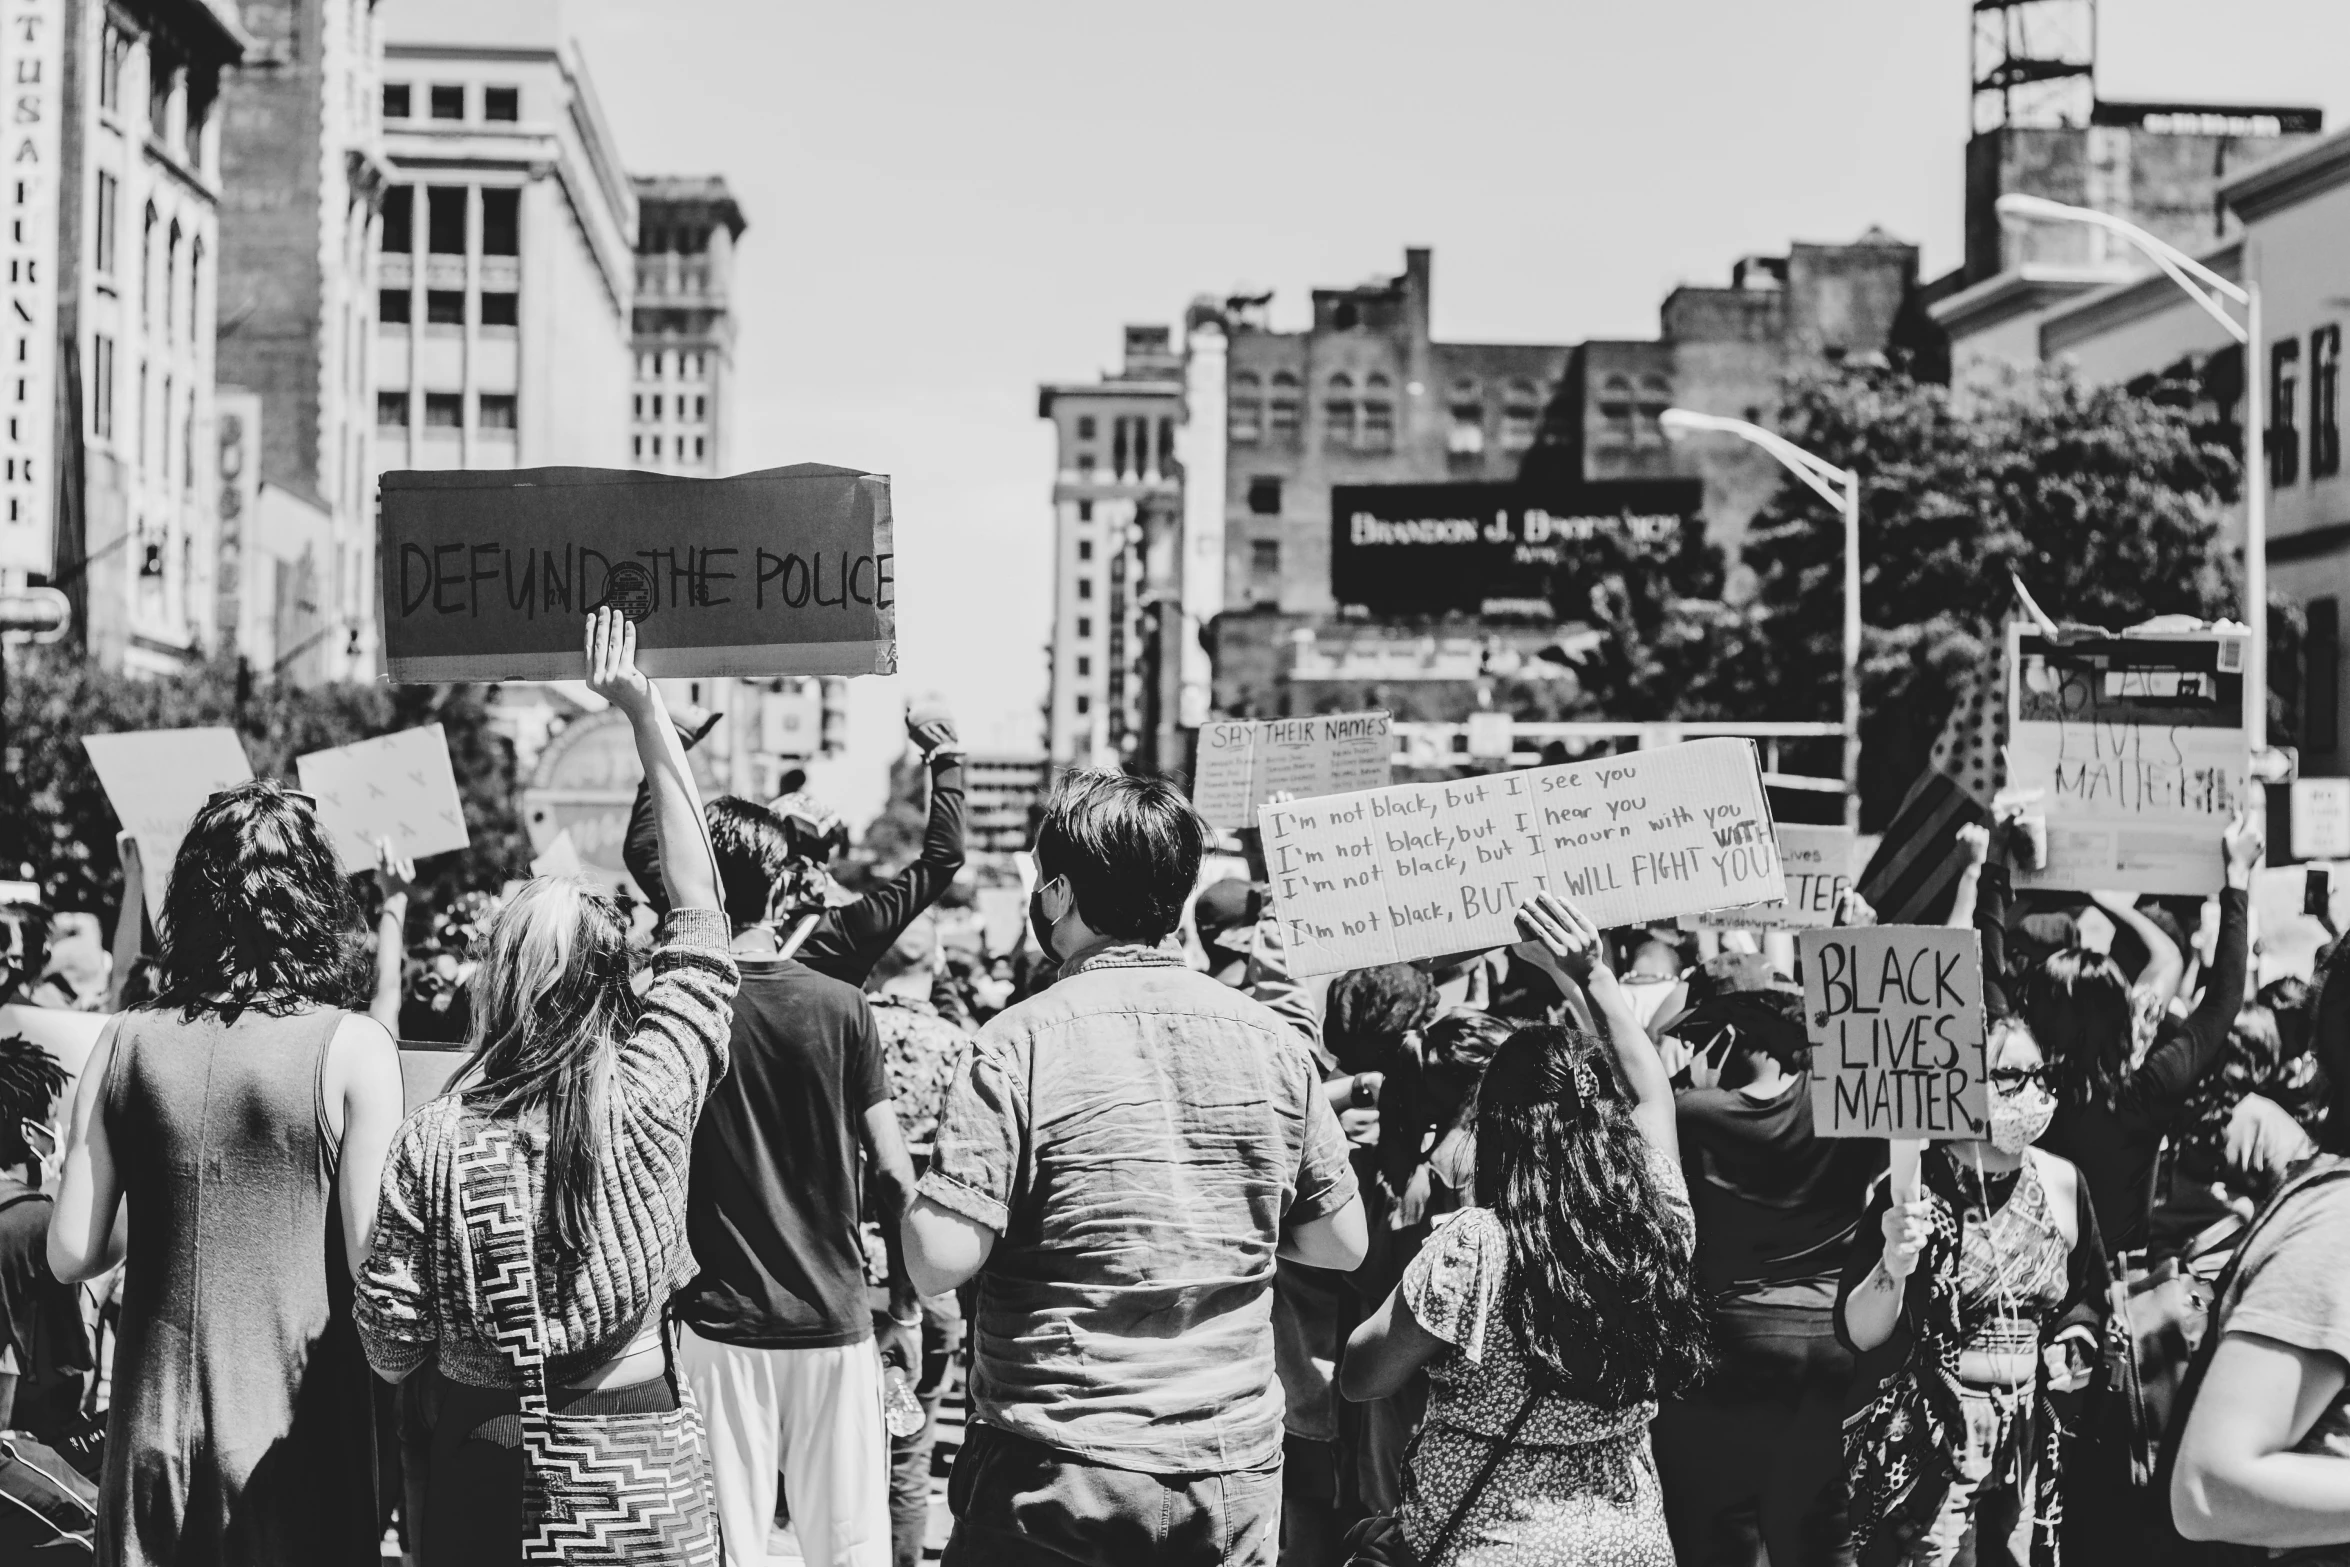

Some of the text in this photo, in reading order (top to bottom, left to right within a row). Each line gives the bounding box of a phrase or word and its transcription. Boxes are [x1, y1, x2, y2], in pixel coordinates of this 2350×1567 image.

[399, 542, 617, 620] DEFUND
[636, 545, 738, 614] THE
[755, 547, 896, 611] POLICE
[1212, 718, 1387, 748] SAY THEIR NAMES
[1271, 764, 1637, 839] I'm not black, but I see you
[1275, 795, 1647, 875] I'm not black, but I hear you
[1282, 803, 1742, 900] I'm not black, but I mourn with you
[1288, 917, 1334, 947] I'm
[1342, 911, 1380, 937] not
[1388, 899, 1453, 926] black,
[1461, 881, 1519, 919] BUT
[1565, 863, 1622, 898] WILL
[1632, 847, 1704, 885] FIGHT
[1712, 845, 1771, 888] YOU
[1819, 942, 1965, 1016] BLACK
[1840, 1014, 1959, 1069] LIVES
[1834, 1068, 1974, 1131] MATTER
